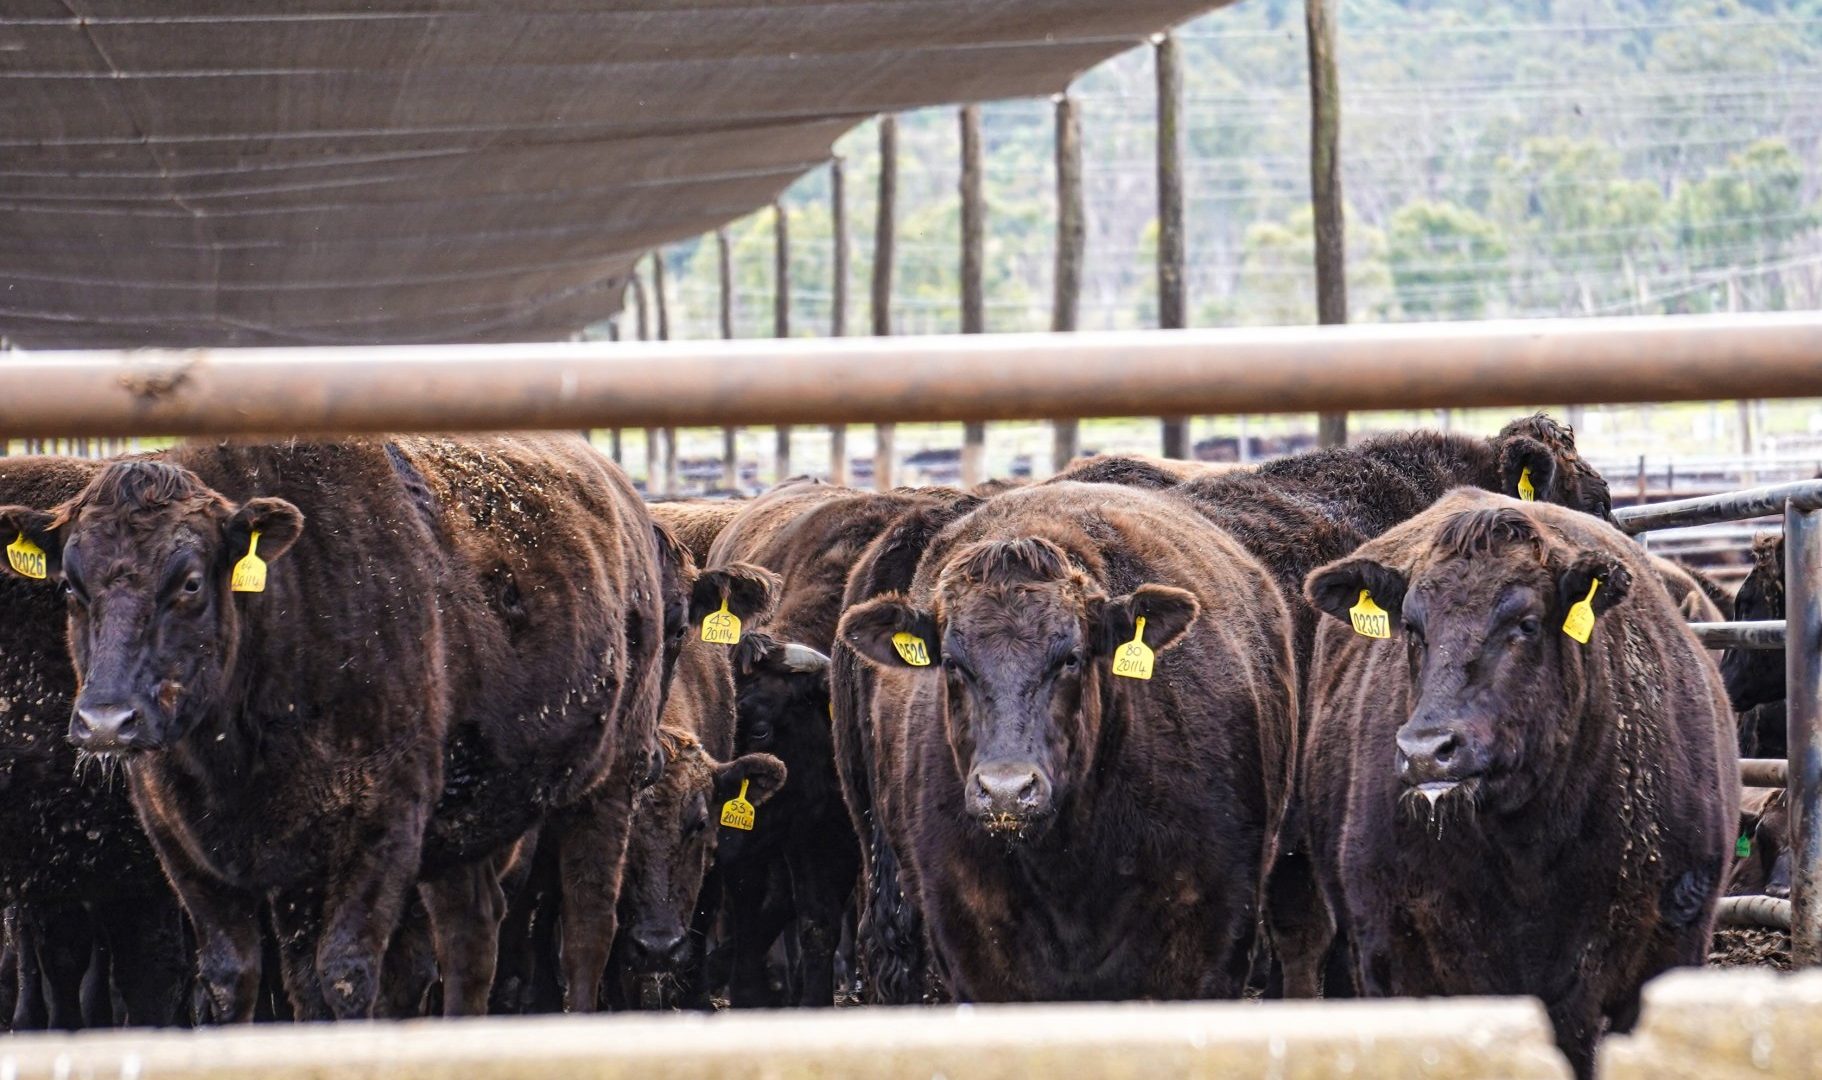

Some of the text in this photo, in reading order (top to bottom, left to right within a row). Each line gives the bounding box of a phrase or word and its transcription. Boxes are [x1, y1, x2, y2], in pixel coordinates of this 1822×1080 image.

[709, 614, 731, 628] 43
[1353, 613, 1386, 637] 02337
[704, 627, 733, 641] 20114
[1125, 644, 1142, 657] 80
[1117, 658, 1146, 676] 20114
[731, 800, 746, 814] 53
[722, 811, 748, 827] 20114
